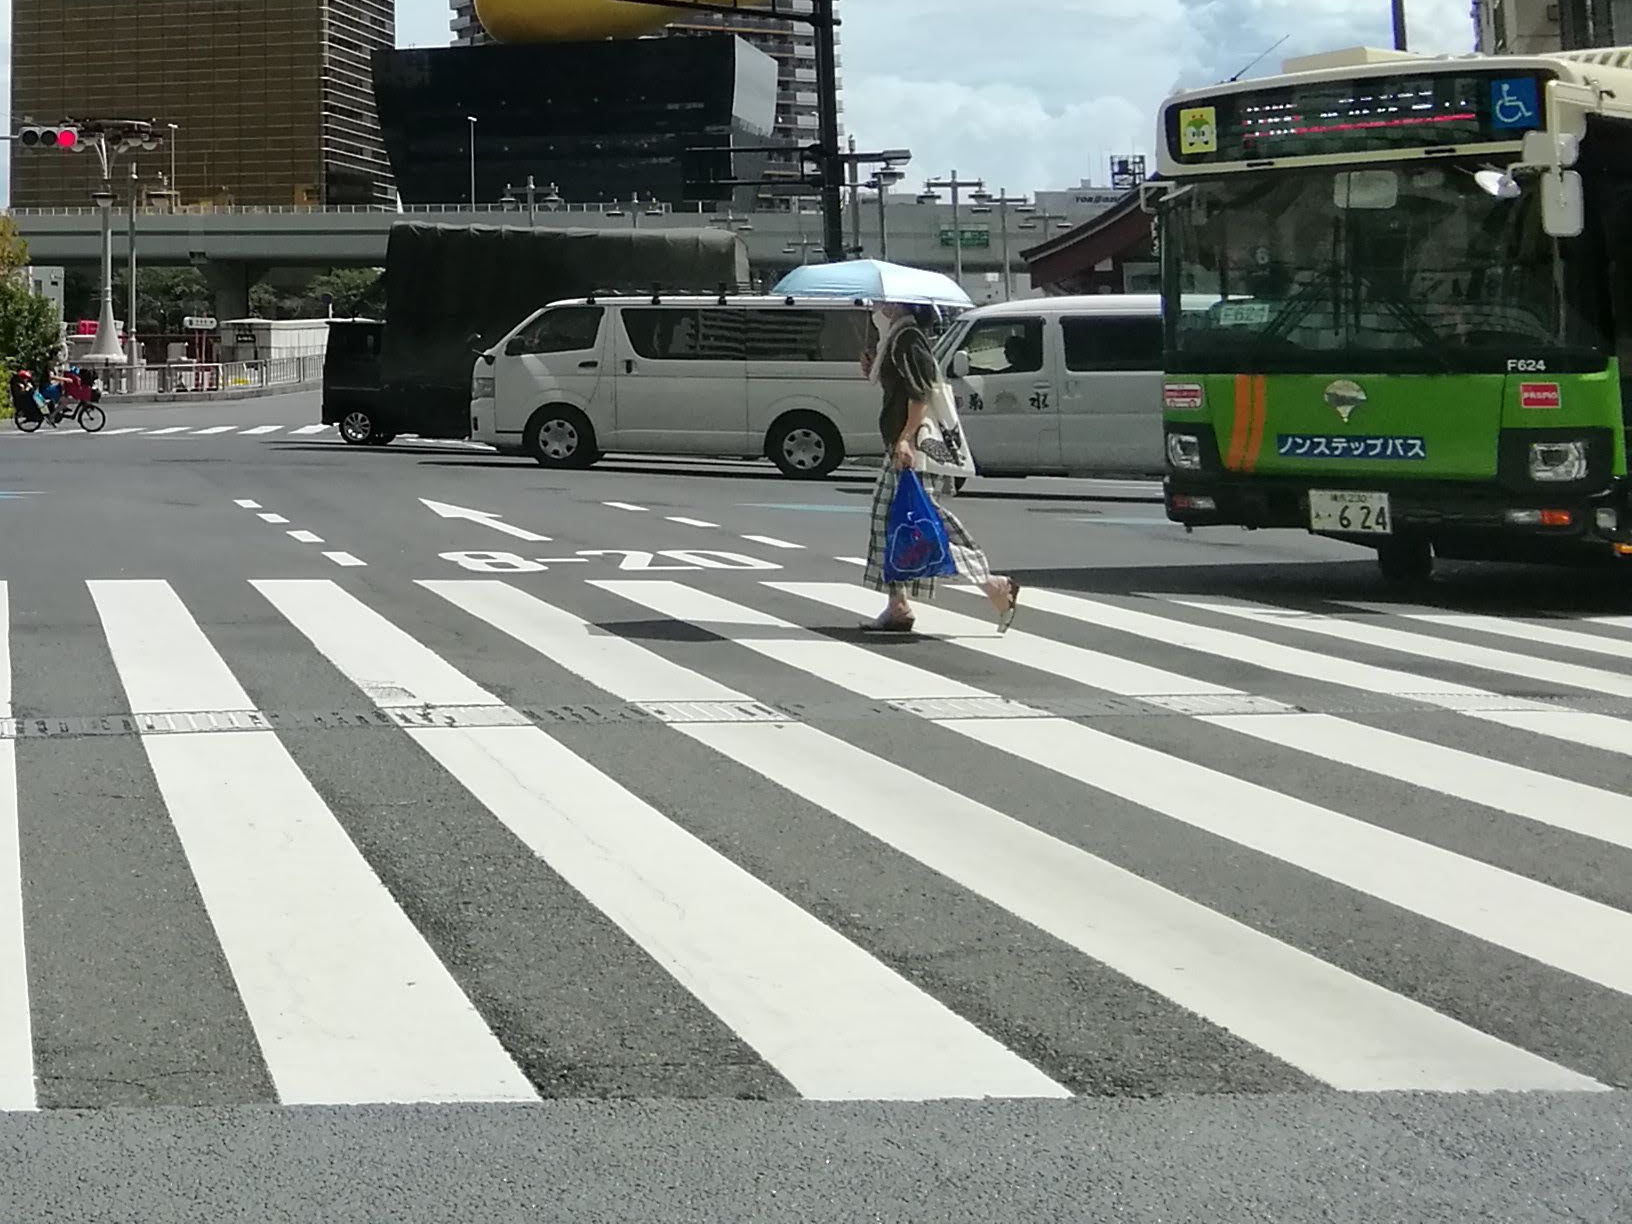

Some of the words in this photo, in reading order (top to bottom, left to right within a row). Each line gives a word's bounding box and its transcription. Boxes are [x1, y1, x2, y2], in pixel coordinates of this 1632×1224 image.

[1506, 359, 1547, 372] F624
[1279, 436, 1426, 457] ノンステップバス
